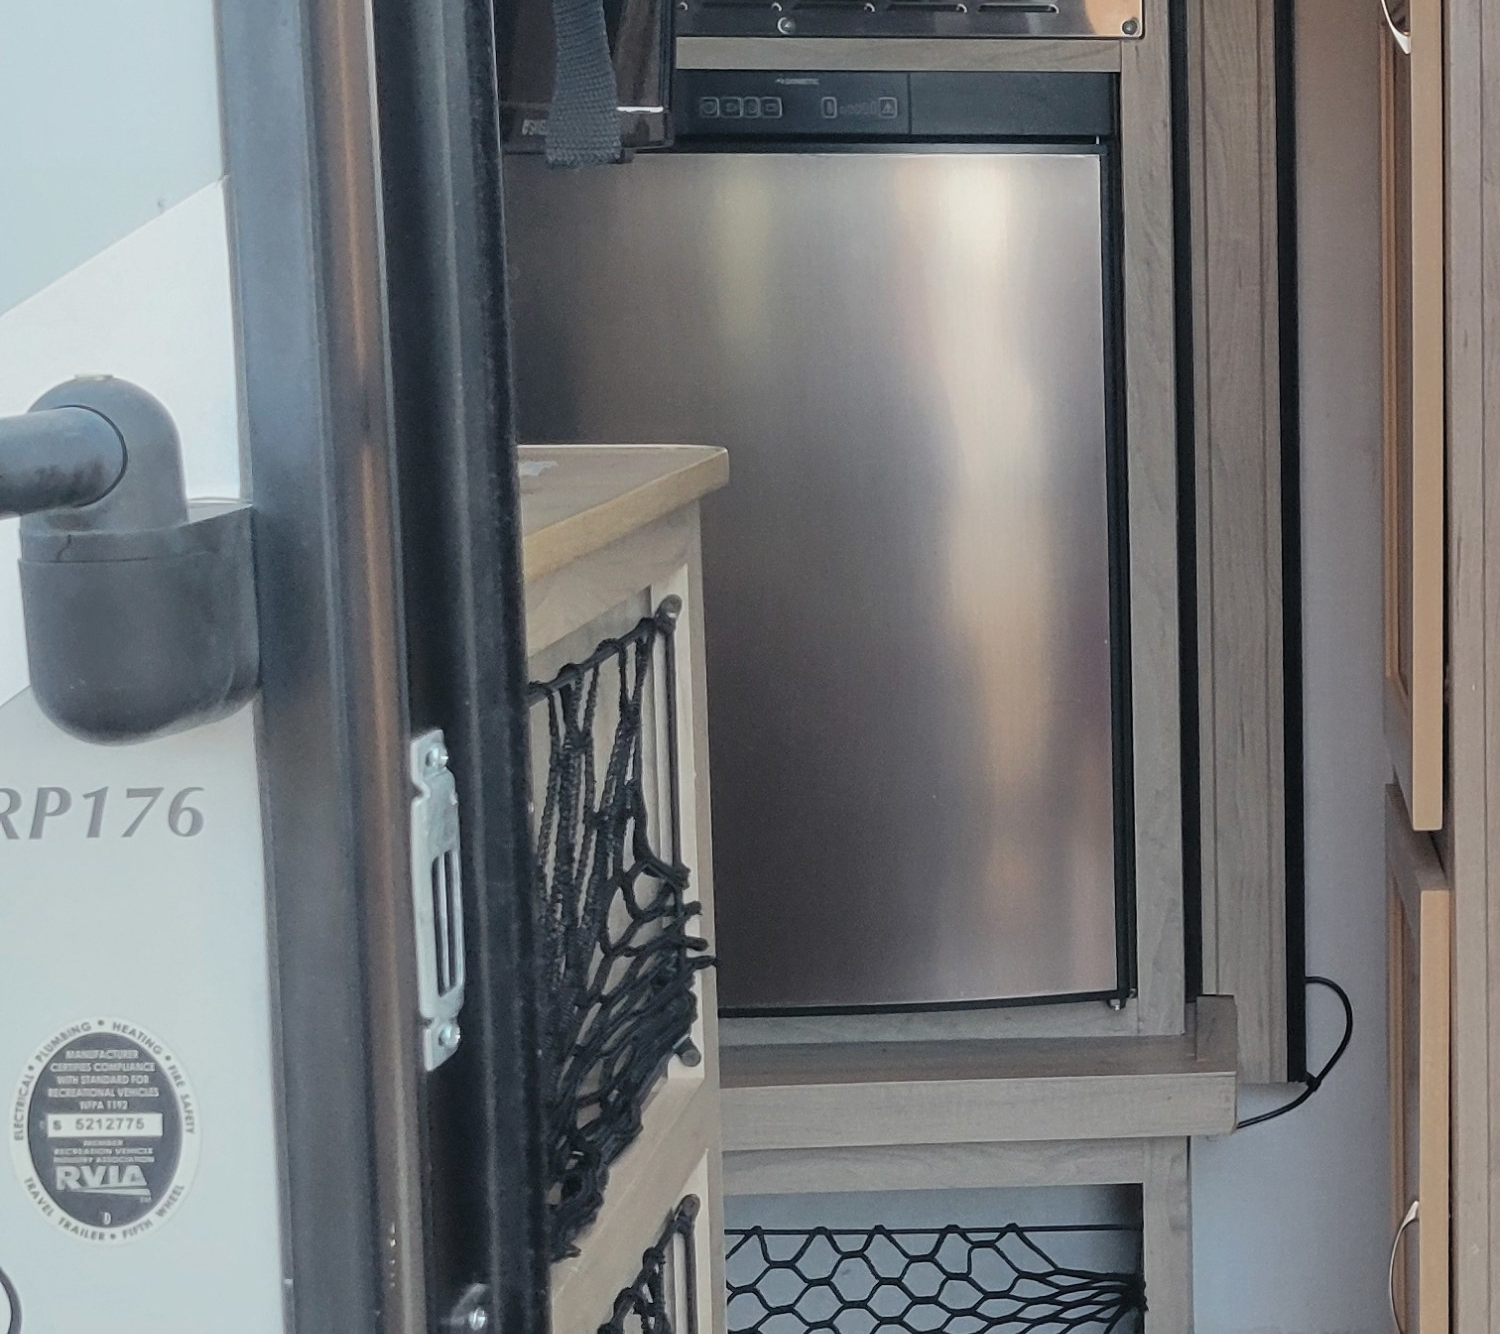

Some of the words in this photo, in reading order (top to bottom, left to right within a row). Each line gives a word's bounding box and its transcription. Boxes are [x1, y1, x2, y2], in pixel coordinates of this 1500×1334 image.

[65, 1050, 139, 1059] MANUFACTURER
[94, 1063, 155, 1072] COMPLIANCE
[14, 1073, 35, 1141] ELECTRICAL
[35, 1022, 92, 1063] PLUMBING
[112, 1022, 163, 1055] HEATING
[168, 1064, 186, 1088] FIRE
[180, 1094, 195, 1134] SAFETY
[57, 1076, 78, 1085] WITH
[81, 1075, 129, 1084] STANDARD
[131, 1075, 149, 1084] FOR
[48, 1088, 115, 1097] RECREATIONAL
[117, 1088, 159, 1097] VEHICLES
[106, 1101, 128, 1110] 1192
[75, 1118, 144, 1130] 5212775
[56, 1165, 147, 1190] RVIA
[24, 1176, 54, 1217] TRAVEL
[58, 1217, 105, 1241] TRAILER
[122, 1220, 153, 1240] FIFTH
[155, 1184, 185, 1217] WHEEL
